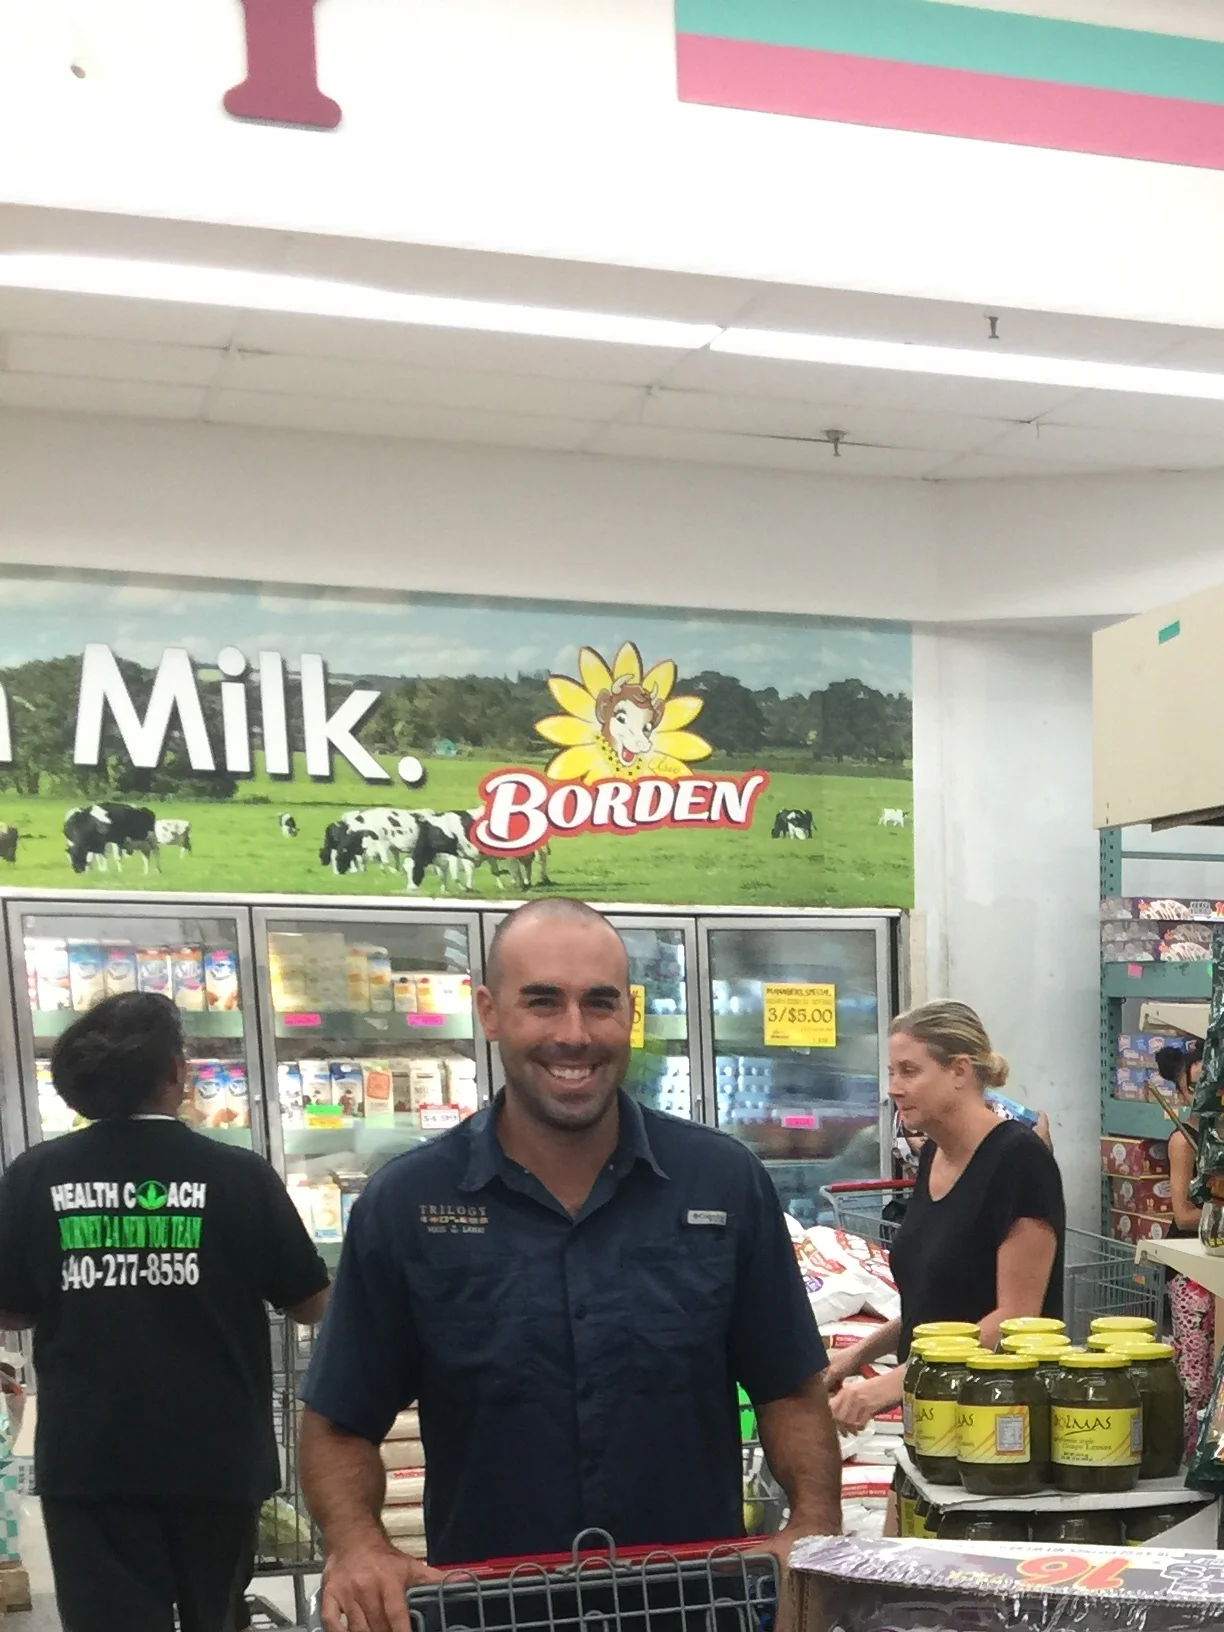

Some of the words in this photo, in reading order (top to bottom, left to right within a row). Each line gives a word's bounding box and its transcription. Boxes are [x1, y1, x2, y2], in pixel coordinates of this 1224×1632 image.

[72, 642, 427, 787] Milk.
[475, 768, 768, 853] BORDEN
[768, 1007, 833, 1024] 3/$5.00
[50, 1181, 120, 1212] HEALTH
[123, 1179, 207, 1210] COACH
[418, 1204, 487, 1217] TRILOGY
